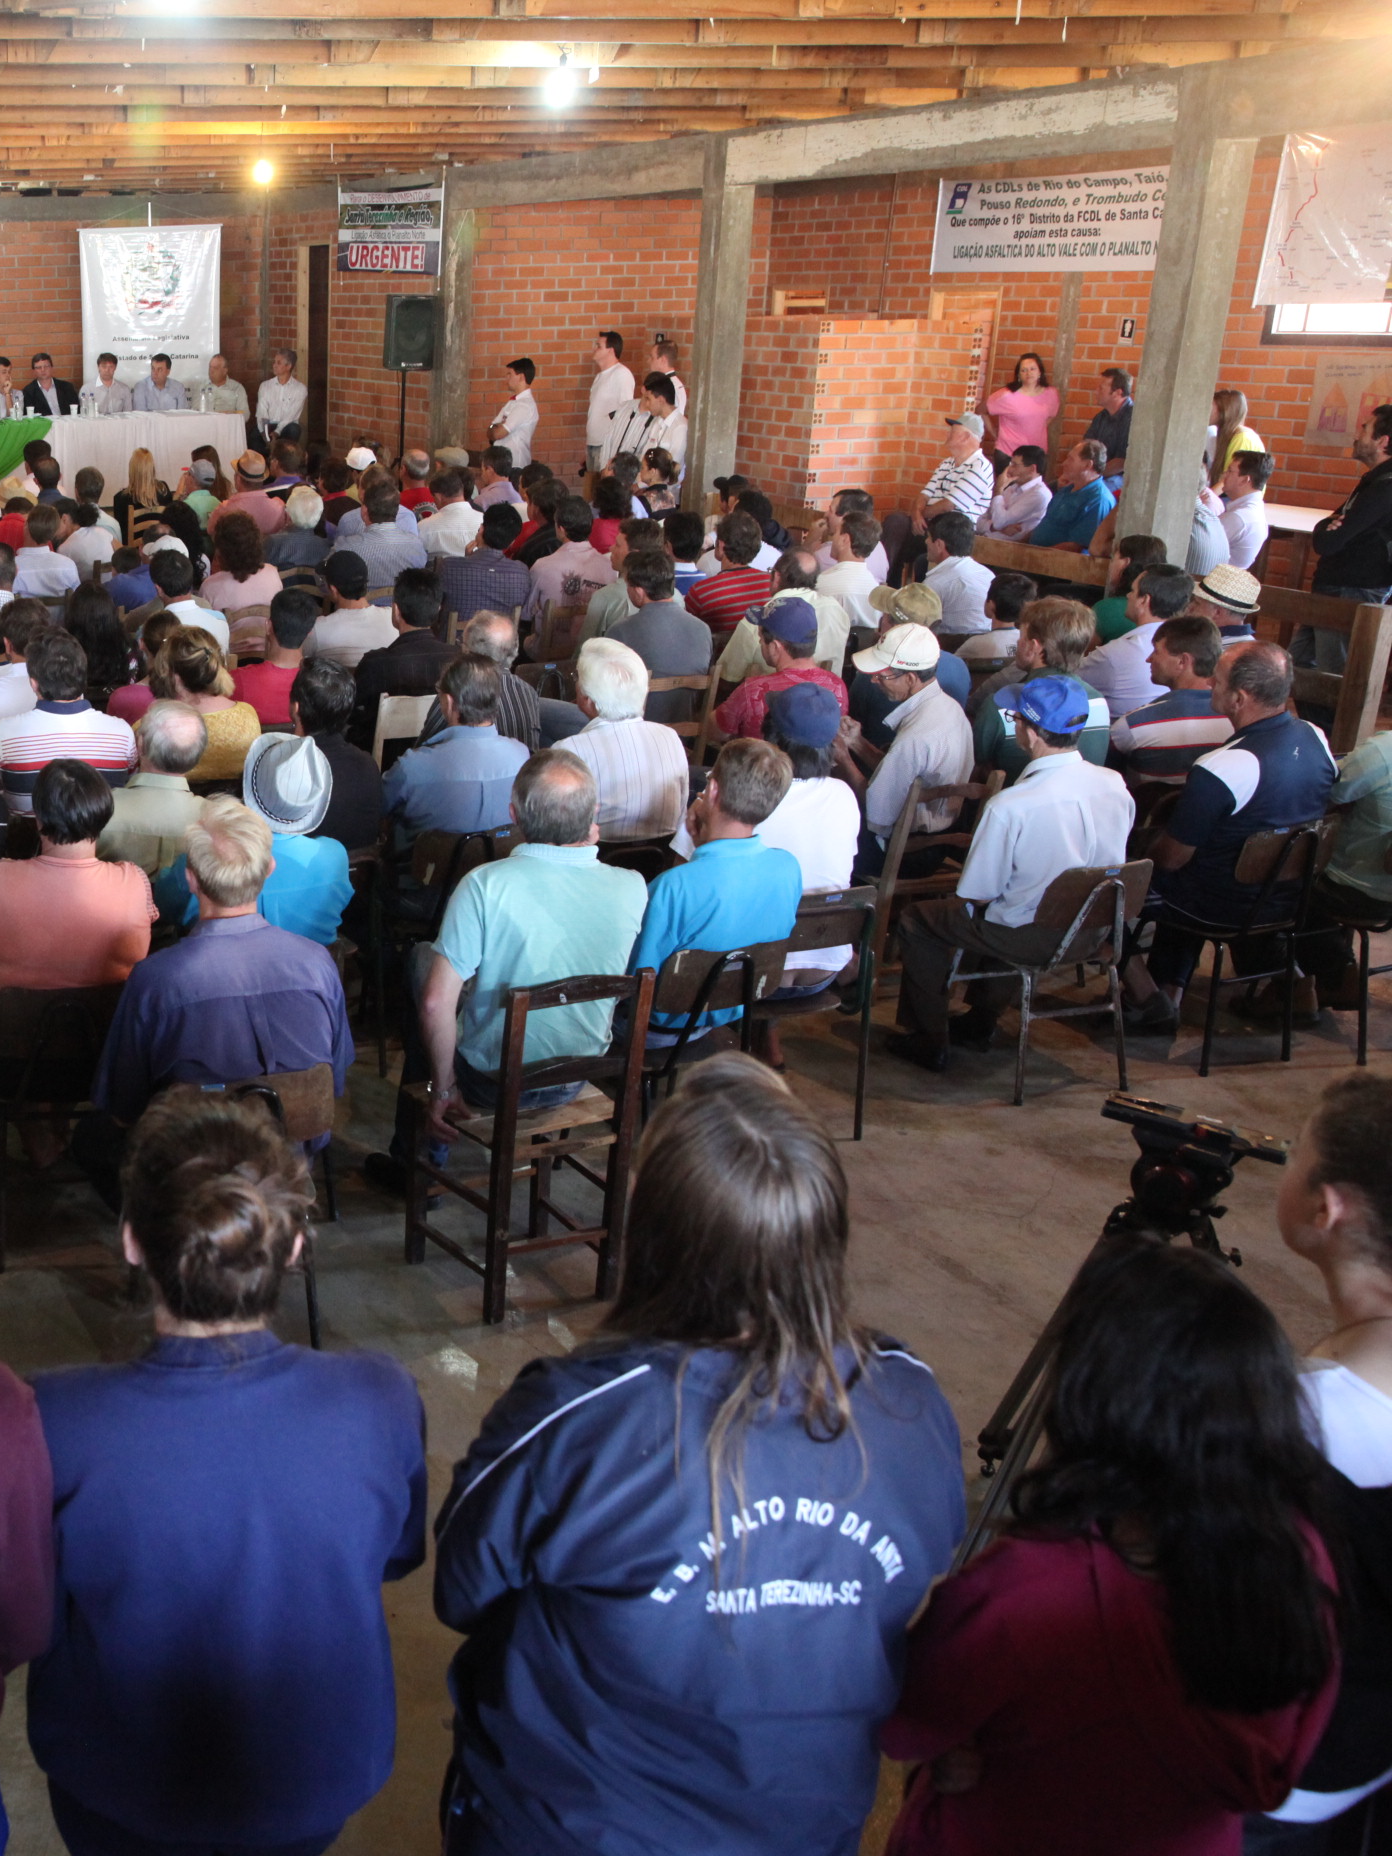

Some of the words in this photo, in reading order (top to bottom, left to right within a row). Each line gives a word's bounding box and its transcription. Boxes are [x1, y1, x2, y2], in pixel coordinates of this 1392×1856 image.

[977, 183, 991, 194] As
[995, 182, 1023, 193] CDLs
[1026, 181, 1040, 192] de
[1042, 179, 1063, 190] Rio
[1066, 179, 1081, 189] do
[1083, 177, 1133, 189] Campo,
[980, 199, 1011, 210] Pouso
[1014, 196, 1068, 209] Redondo,
[1072, 197, 1081, 206] e
[1085, 190, 1148, 206] Trombudo
[365, 206, 396, 224] Terezinha
[950, 216, 967, 227] Que
[968, 215, 1001, 228] compõe
[1003, 218, 1009, 226] o
[1029, 213, 1060, 224] Distrito
[1063, 212, 1074, 223] da
[1077, 210, 1102, 222] FCDL
[1104, 210, 1116, 221] de
[1120, 208, 1149, 220] Santa
[1013, 228, 1046, 241] apoiam
[1048, 228, 1068, 238] esta
[1070, 228, 1101, 237] causa:
[349, 244, 425, 270] URGENTE!
[953, 242, 983, 261] LIGAÇÃO
[1024, 244, 1035, 257] DO
[1036, 243, 1056, 257] ALTO
[1059, 242, 1078, 257] VALE
[1080, 242, 1098, 256] COM
[1099, 242, 1106, 256] O
[1107, 241, 1152, 256] PLANALTO
[673, 1564, 700, 1583] B.
[731, 1496, 786, 1540] ALTO
[795, 1497, 835, 1527] RIO
[839, 1511, 872, 1546] DA
[870, 1535, 905, 1584] ANTA
[705, 1587, 758, 1614] SANTA
[760, 1578, 862, 1608] TEREZINHA-SC
